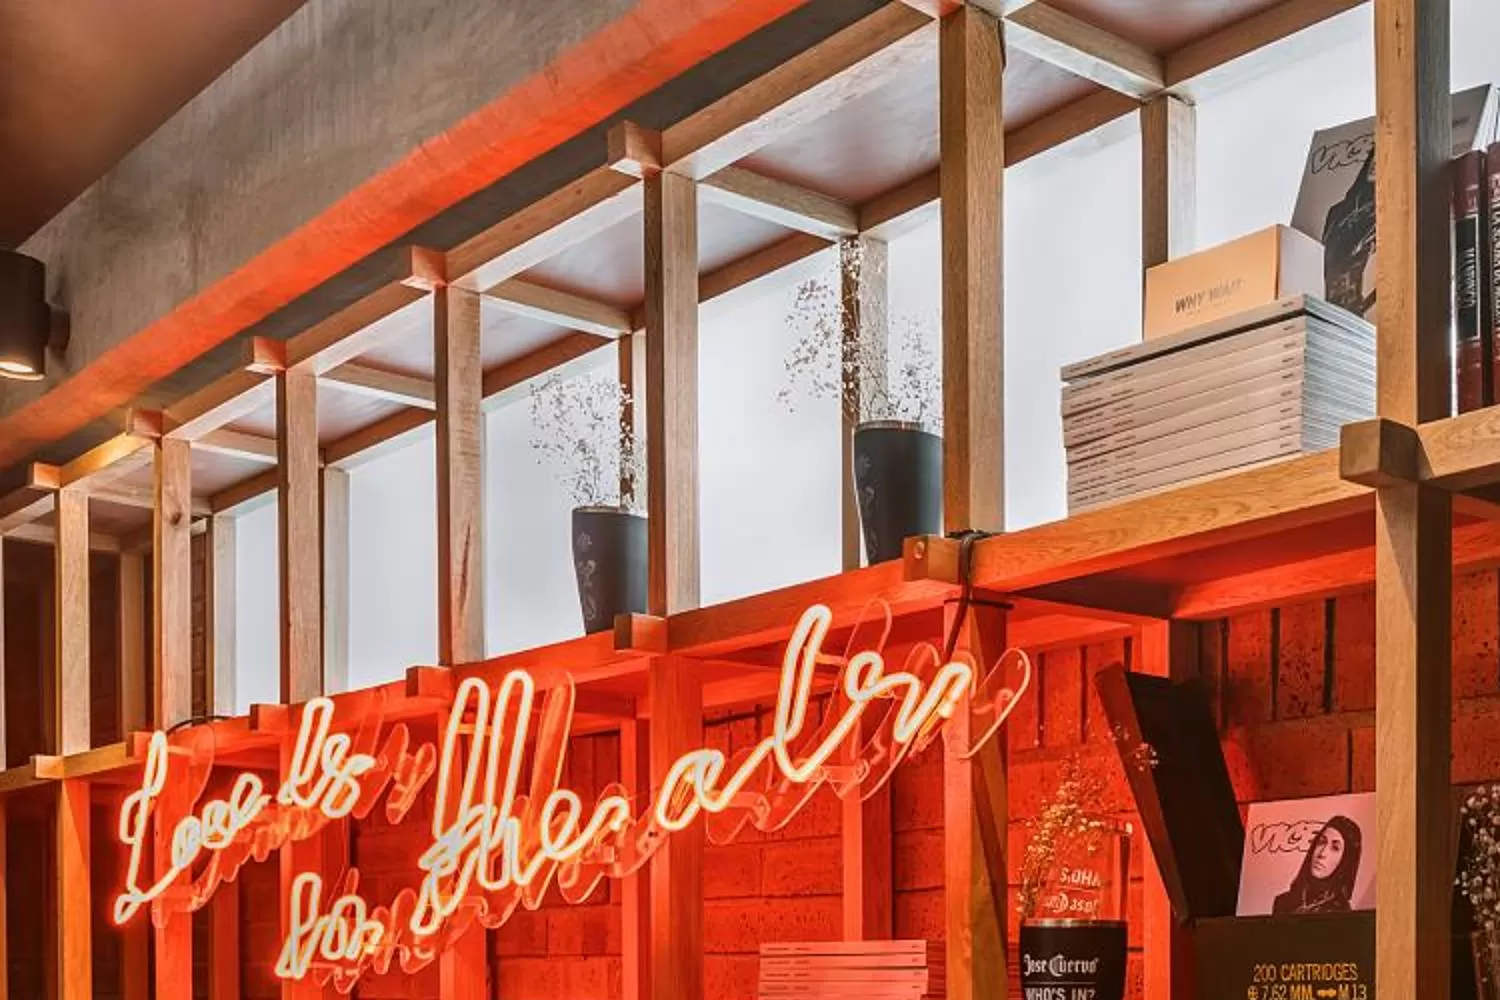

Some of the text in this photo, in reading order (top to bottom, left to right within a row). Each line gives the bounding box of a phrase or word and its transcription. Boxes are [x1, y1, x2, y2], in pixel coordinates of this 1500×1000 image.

[1048, 953, 1099, 977] Cuervo
[1253, 963, 1359, 982] 200 CARTRIDGES
